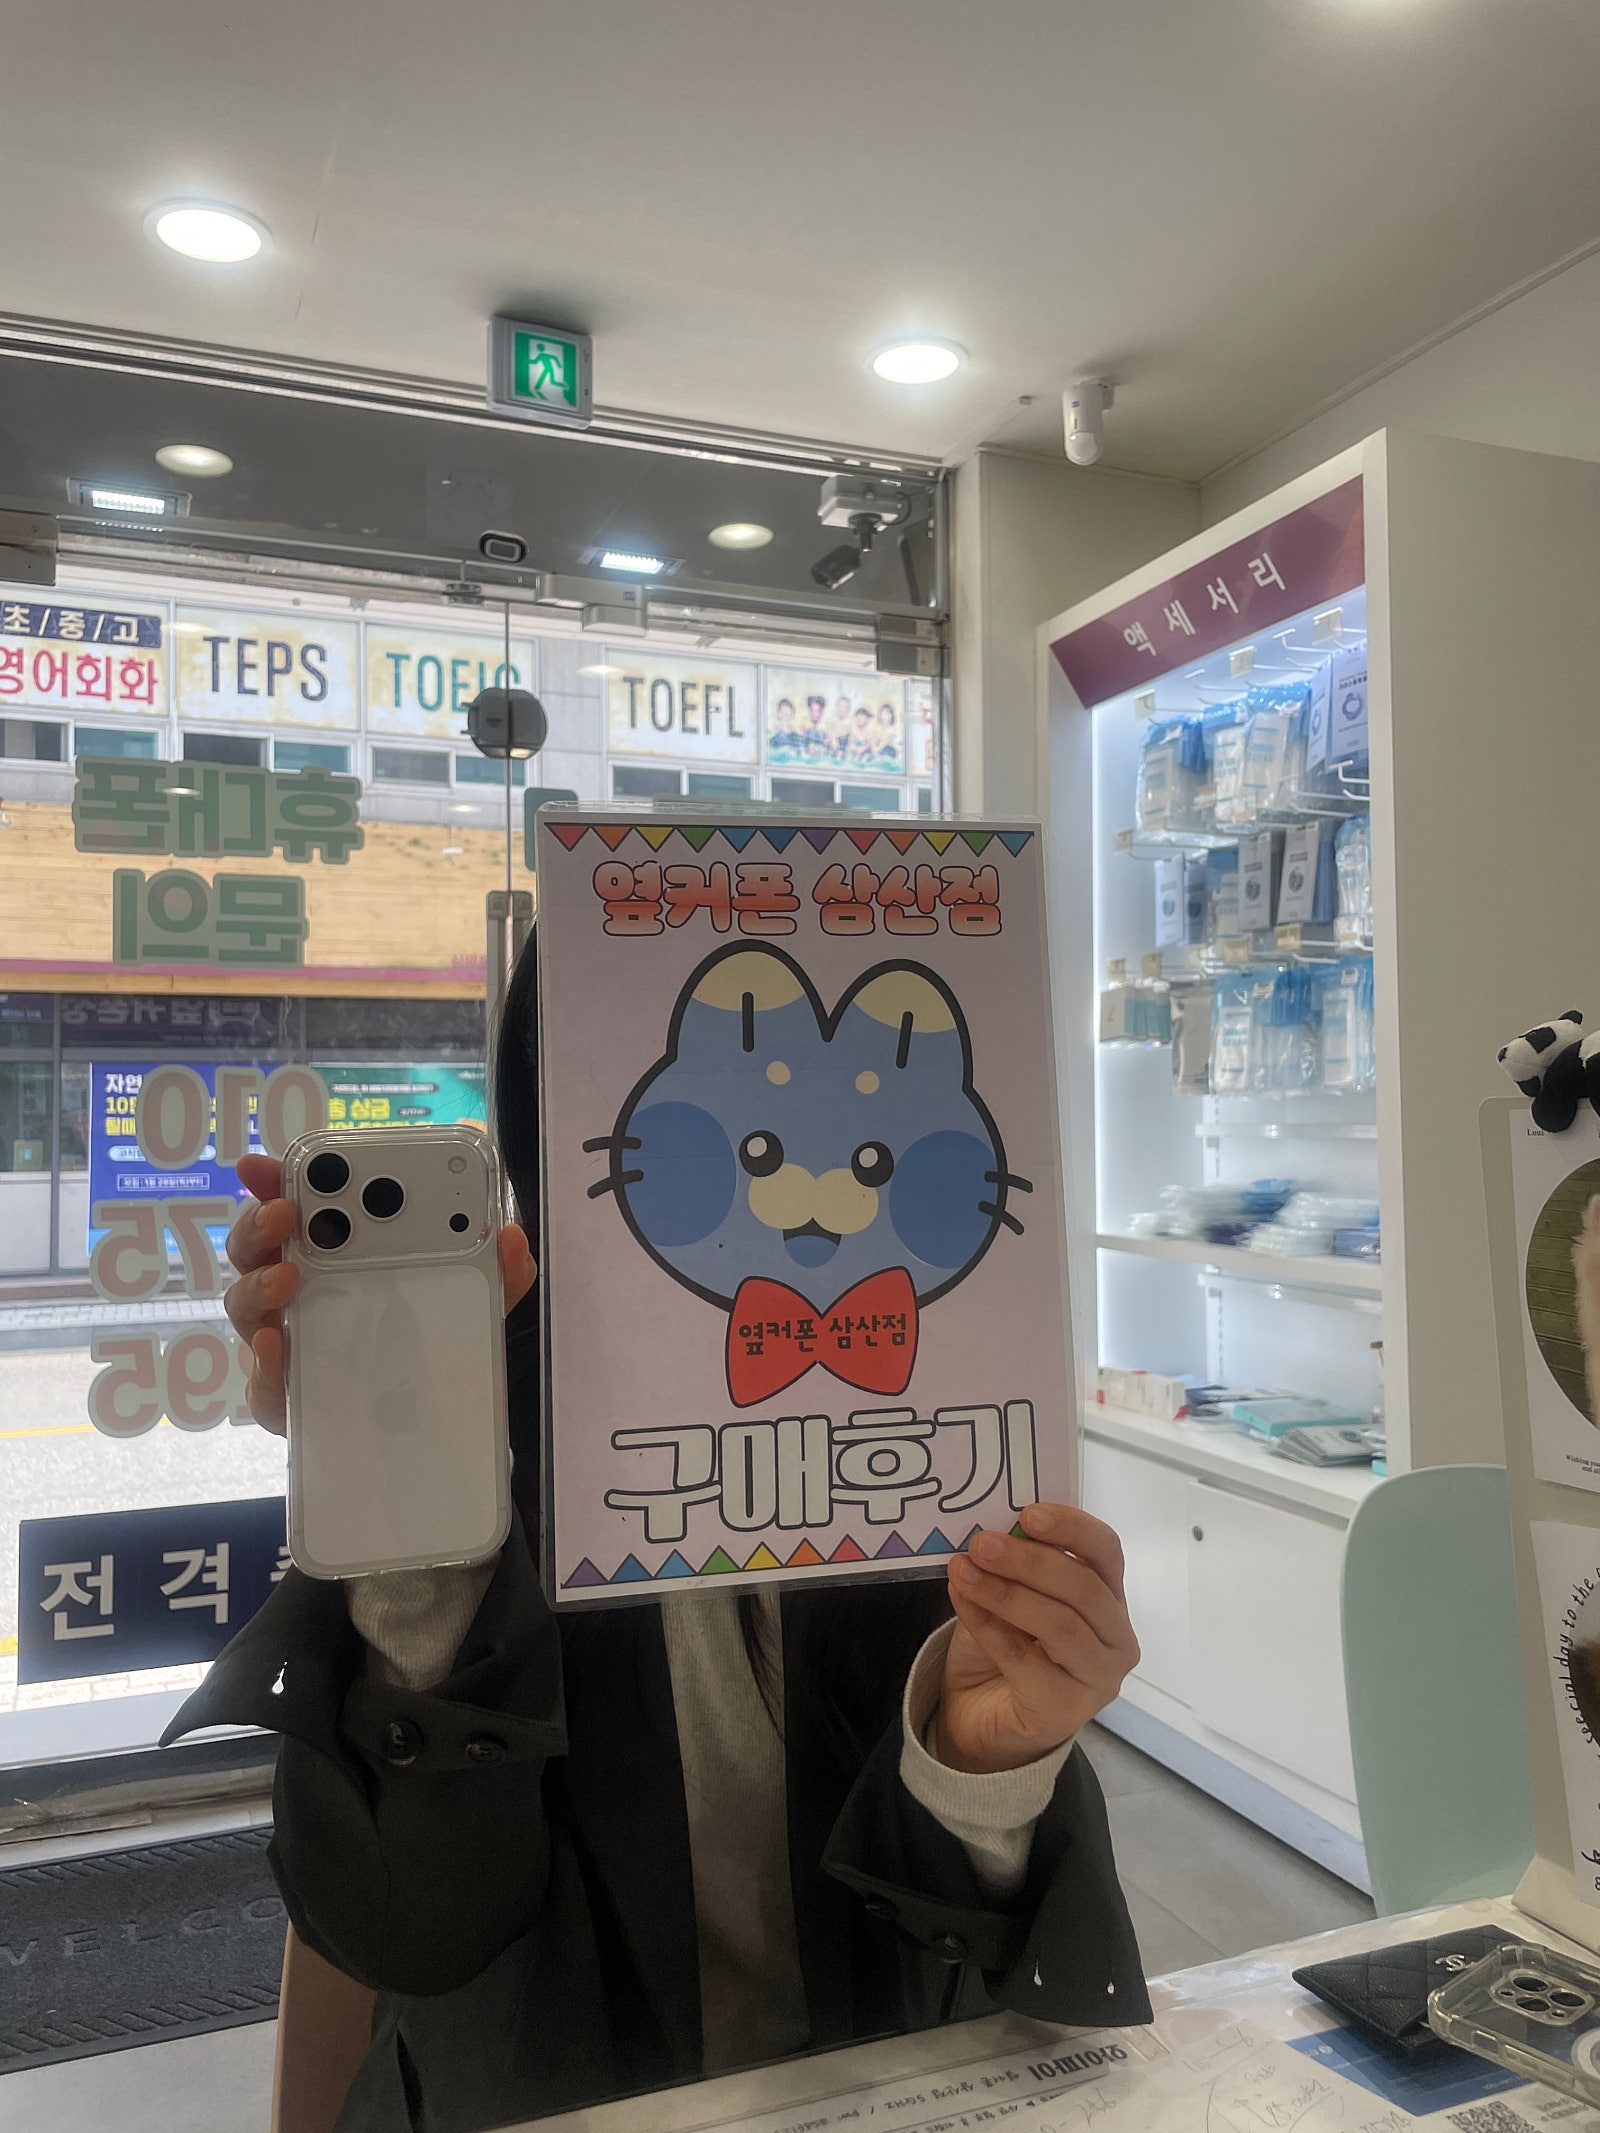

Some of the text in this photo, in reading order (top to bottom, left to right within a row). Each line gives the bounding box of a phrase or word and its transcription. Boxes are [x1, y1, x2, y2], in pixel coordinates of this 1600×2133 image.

[1123, 552, 1286, 656] 액세서리
[0, 646, 158, 704] 영어회화
[203, 635, 328, 702] TEPS
[623, 676, 744, 738] TOEFL
[593, 860, 1003, 936] 옆커폰 삼산점
[739, 1313, 906, 1356] 옆커폰 삼산점
[604, 1399, 1039, 1544] 구매후기
[1561, 1608, 1578, 1629] to
[1571, 1577, 1595, 1606] the
[1553, 1633, 1574, 1667] day
[1026, 2043, 1128, 2081] 와이파이
